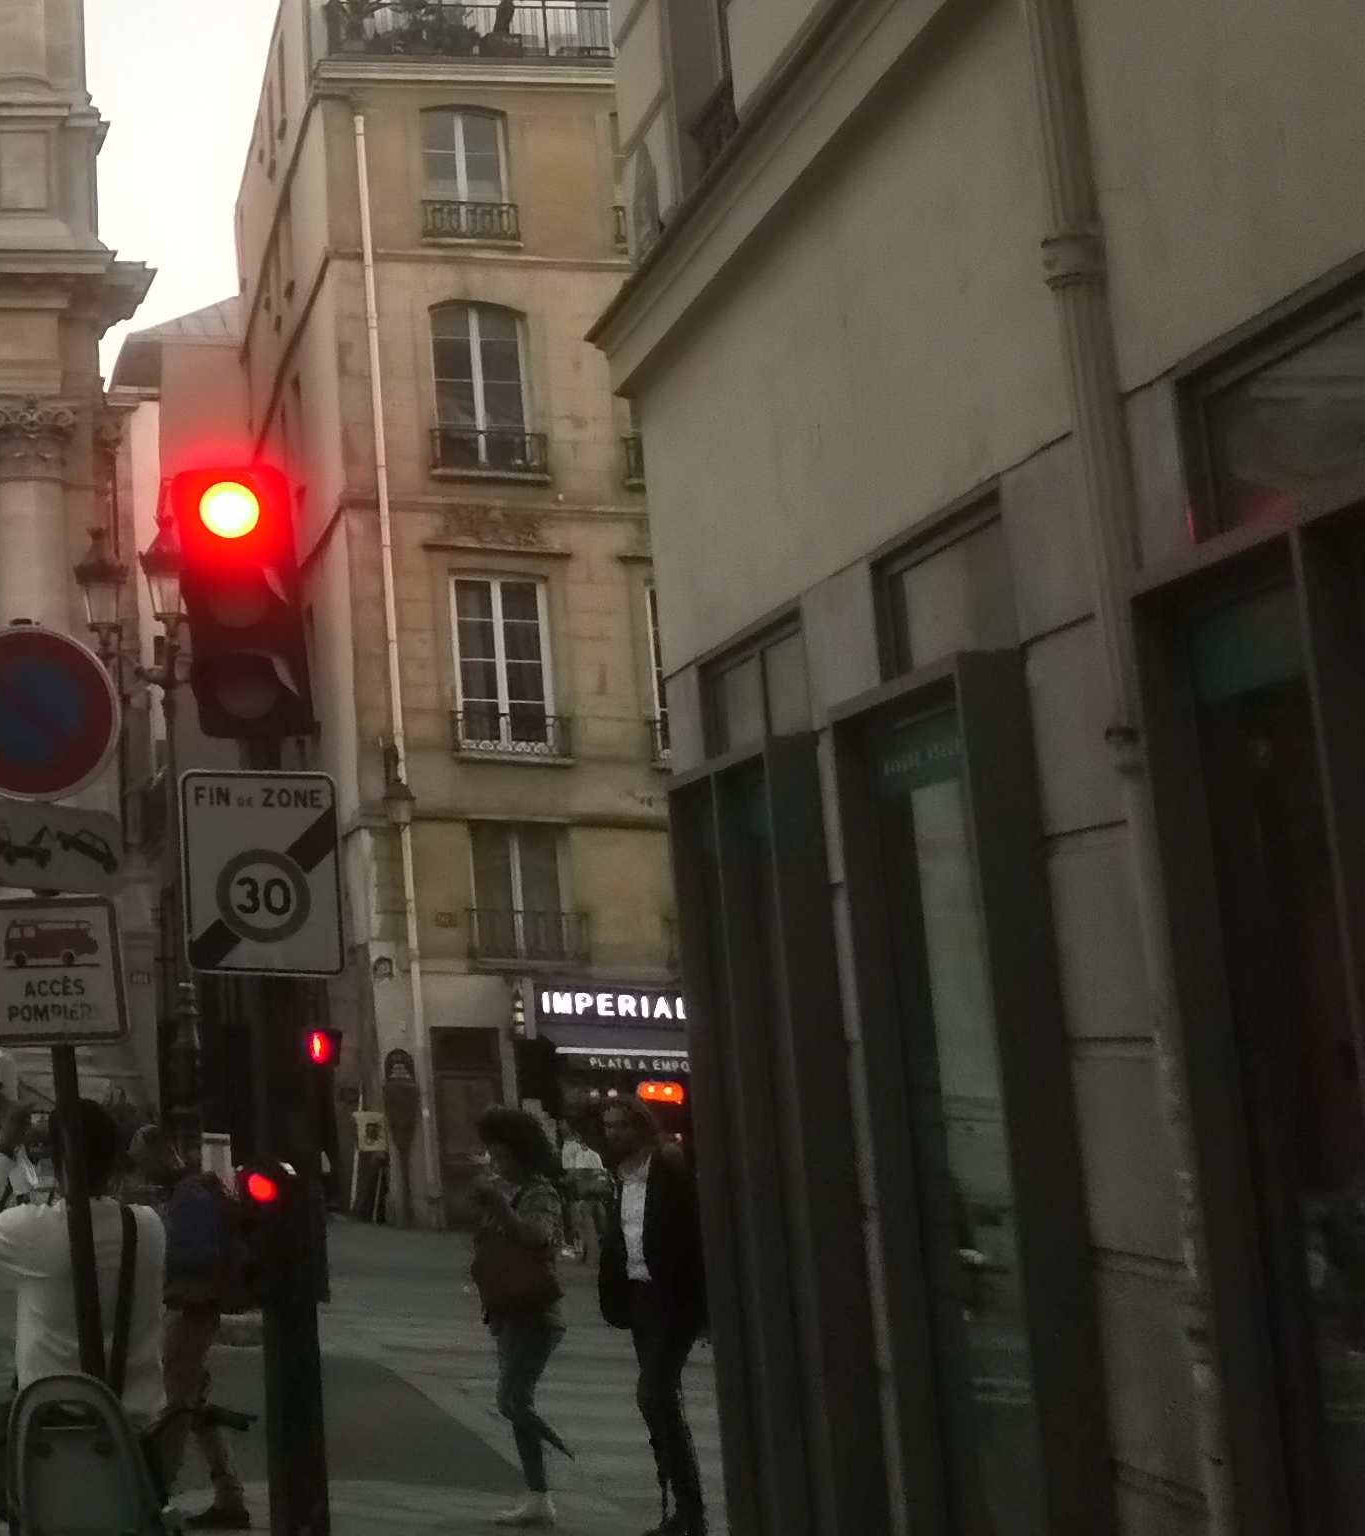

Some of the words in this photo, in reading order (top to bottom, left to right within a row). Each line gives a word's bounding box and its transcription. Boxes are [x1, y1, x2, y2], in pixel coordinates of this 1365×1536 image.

[193, 785, 231, 807] FIN
[261, 787, 324, 809] ZONE
[236, 876, 291, 916] 30
[7, 1003, 102, 1023] POMPIER
[541, 991, 687, 1020] IMPERIAL
[589, 1056, 632, 1070] PLATS
